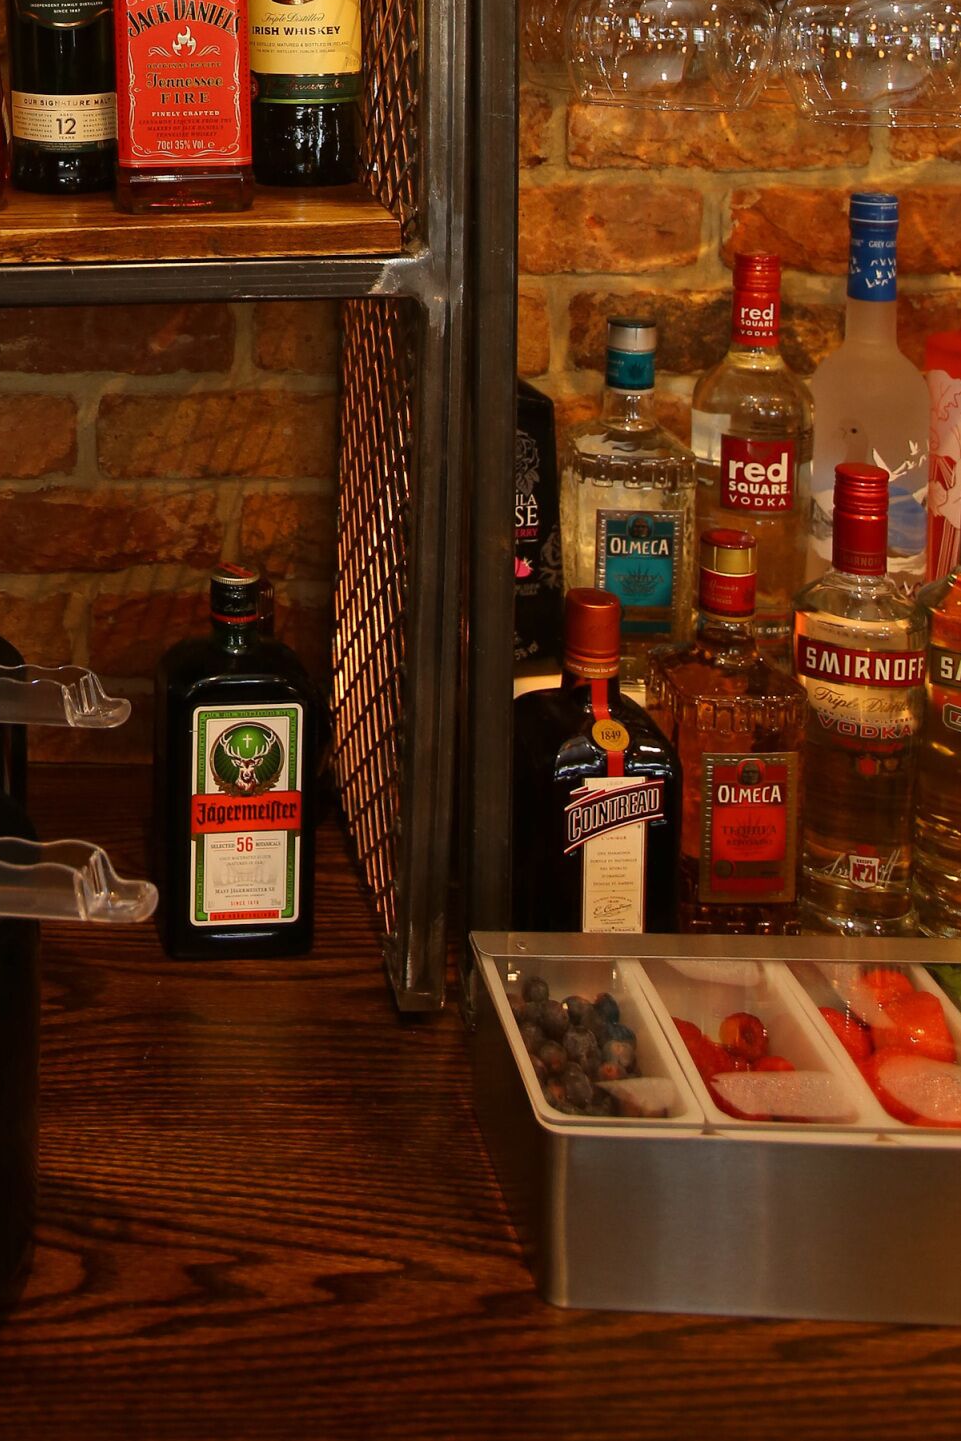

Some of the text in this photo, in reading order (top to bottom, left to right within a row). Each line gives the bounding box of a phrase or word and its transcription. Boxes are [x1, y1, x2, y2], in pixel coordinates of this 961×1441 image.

[126, 1, 171, 37] JACK
[262, 12, 325, 25] Triple Distilled
[252, 25, 341, 35] IRISH WHISKEY
[146, 72, 223, 88] Tennessee
[94, 97, 111, 105] MALT
[161, 91, 209, 104] FIRE
[56, 117, 76, 135] 12
[157, 140, 172, 150] 70cl
[174, 140, 191, 150] 35%
[868, 240, 884, 248] GREY
[741, 303, 774, 320] red
[741, 318, 773, 328] SQUARE
[741, 329, 773, 337] VODKA
[729, 453, 788, 483] red
[729, 481, 788, 495] SQUARE
[729, 494, 786, 506] VODKA
[610, 536, 669, 557] OLMECA
[766, 626, 790, 634] GRAIN
[806, 646, 924, 681] SMIRNOFF
[818, 711, 913, 740] VODKA
[601, 730, 622, 741] 1849
[717, 785, 781, 803] OLMECA
[196, 800, 297, 825] Jägermeister
[567, 788, 660, 842] COINTREAU
[236, 836, 253, 853] 56
